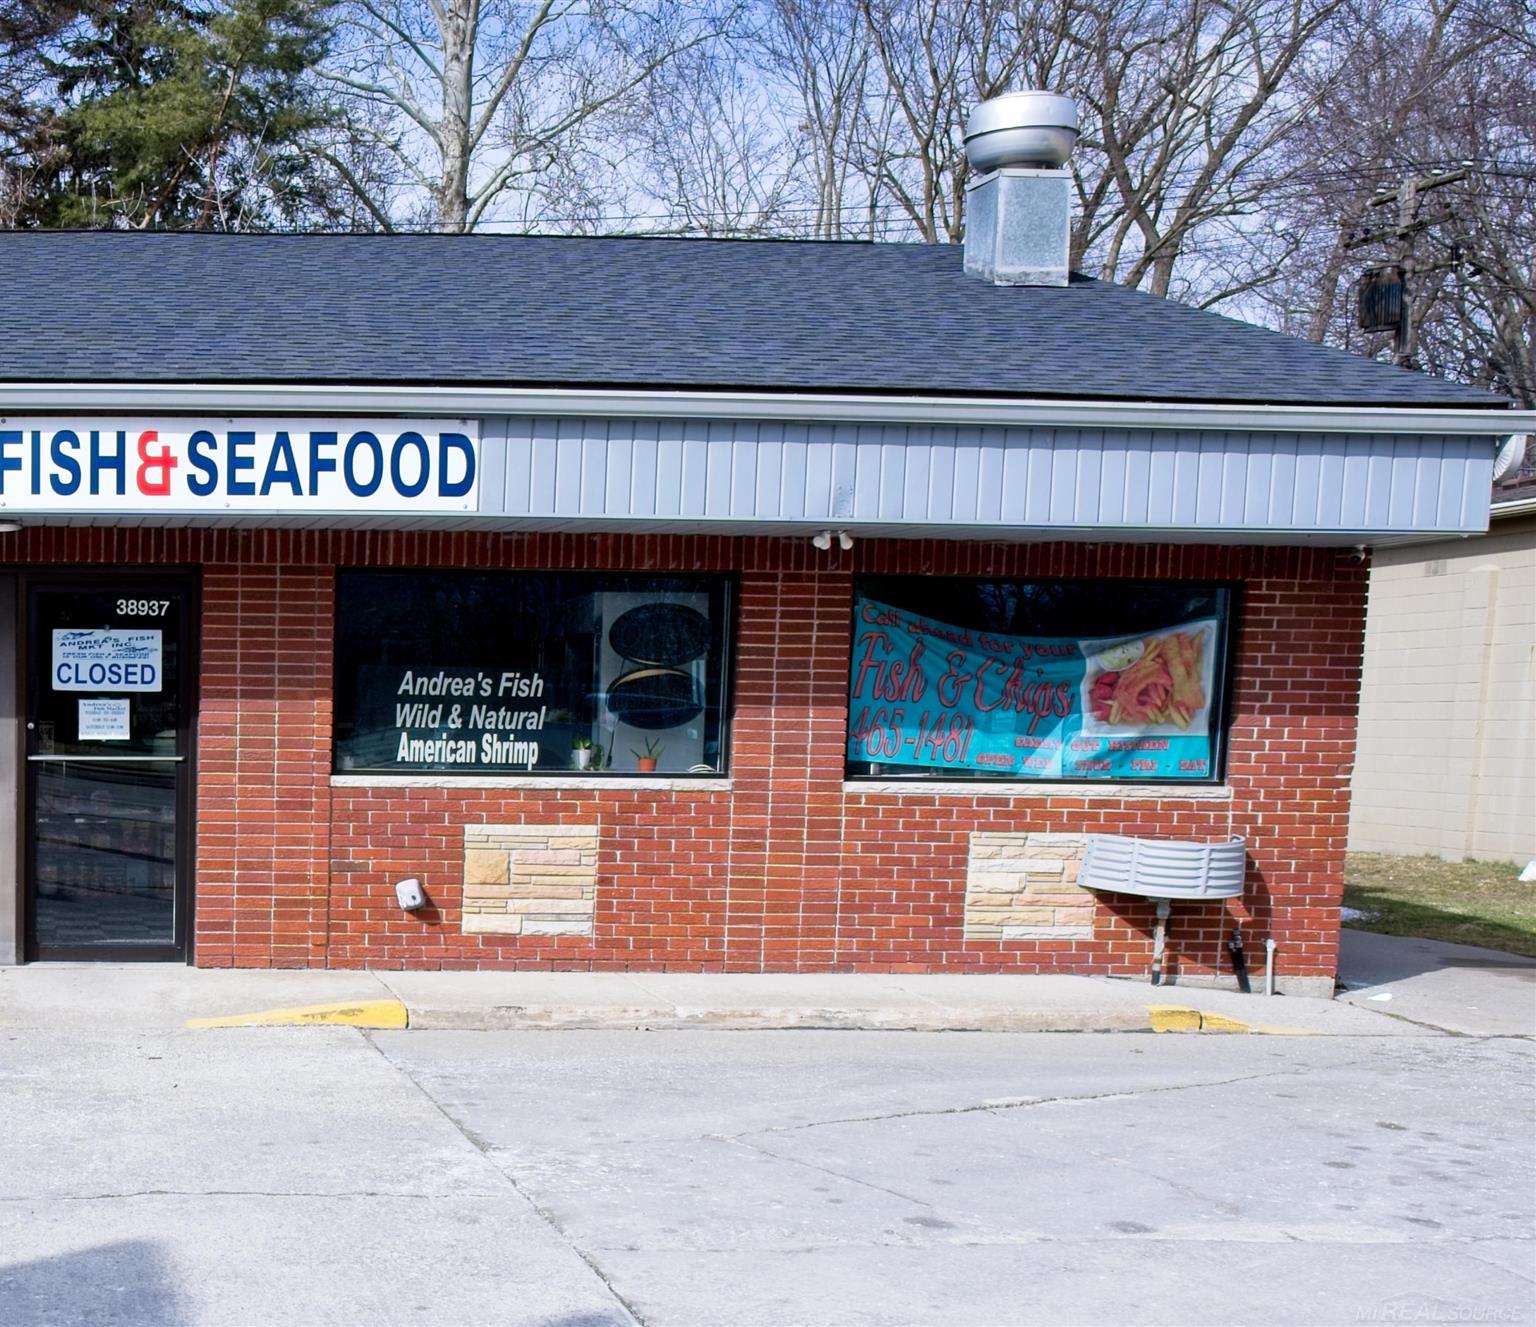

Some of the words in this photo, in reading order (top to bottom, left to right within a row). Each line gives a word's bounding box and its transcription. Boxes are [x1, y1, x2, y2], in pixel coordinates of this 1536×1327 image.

[116, 599, 170, 616] 38937
[862, 604, 900, 628] Call
[978, 636, 1014, 653] for
[1019, 641, 1076, 660] your
[57, 663, 156, 685] CLOSED
[397, 670, 492, 697] Andrea's
[498, 672, 544, 698] Fish
[852, 631, 928, 702] Fish
[938, 650, 973, 708] &
[974, 656, 1075, 735] Chips
[395, 703, 443, 730] Wild
[447, 706, 463, 729] &
[468, 705, 546, 730] Natural
[397, 732, 476, 764] American
[481, 732, 539, 770] Shrimp
[849, 706, 975, 763] 465-1481
